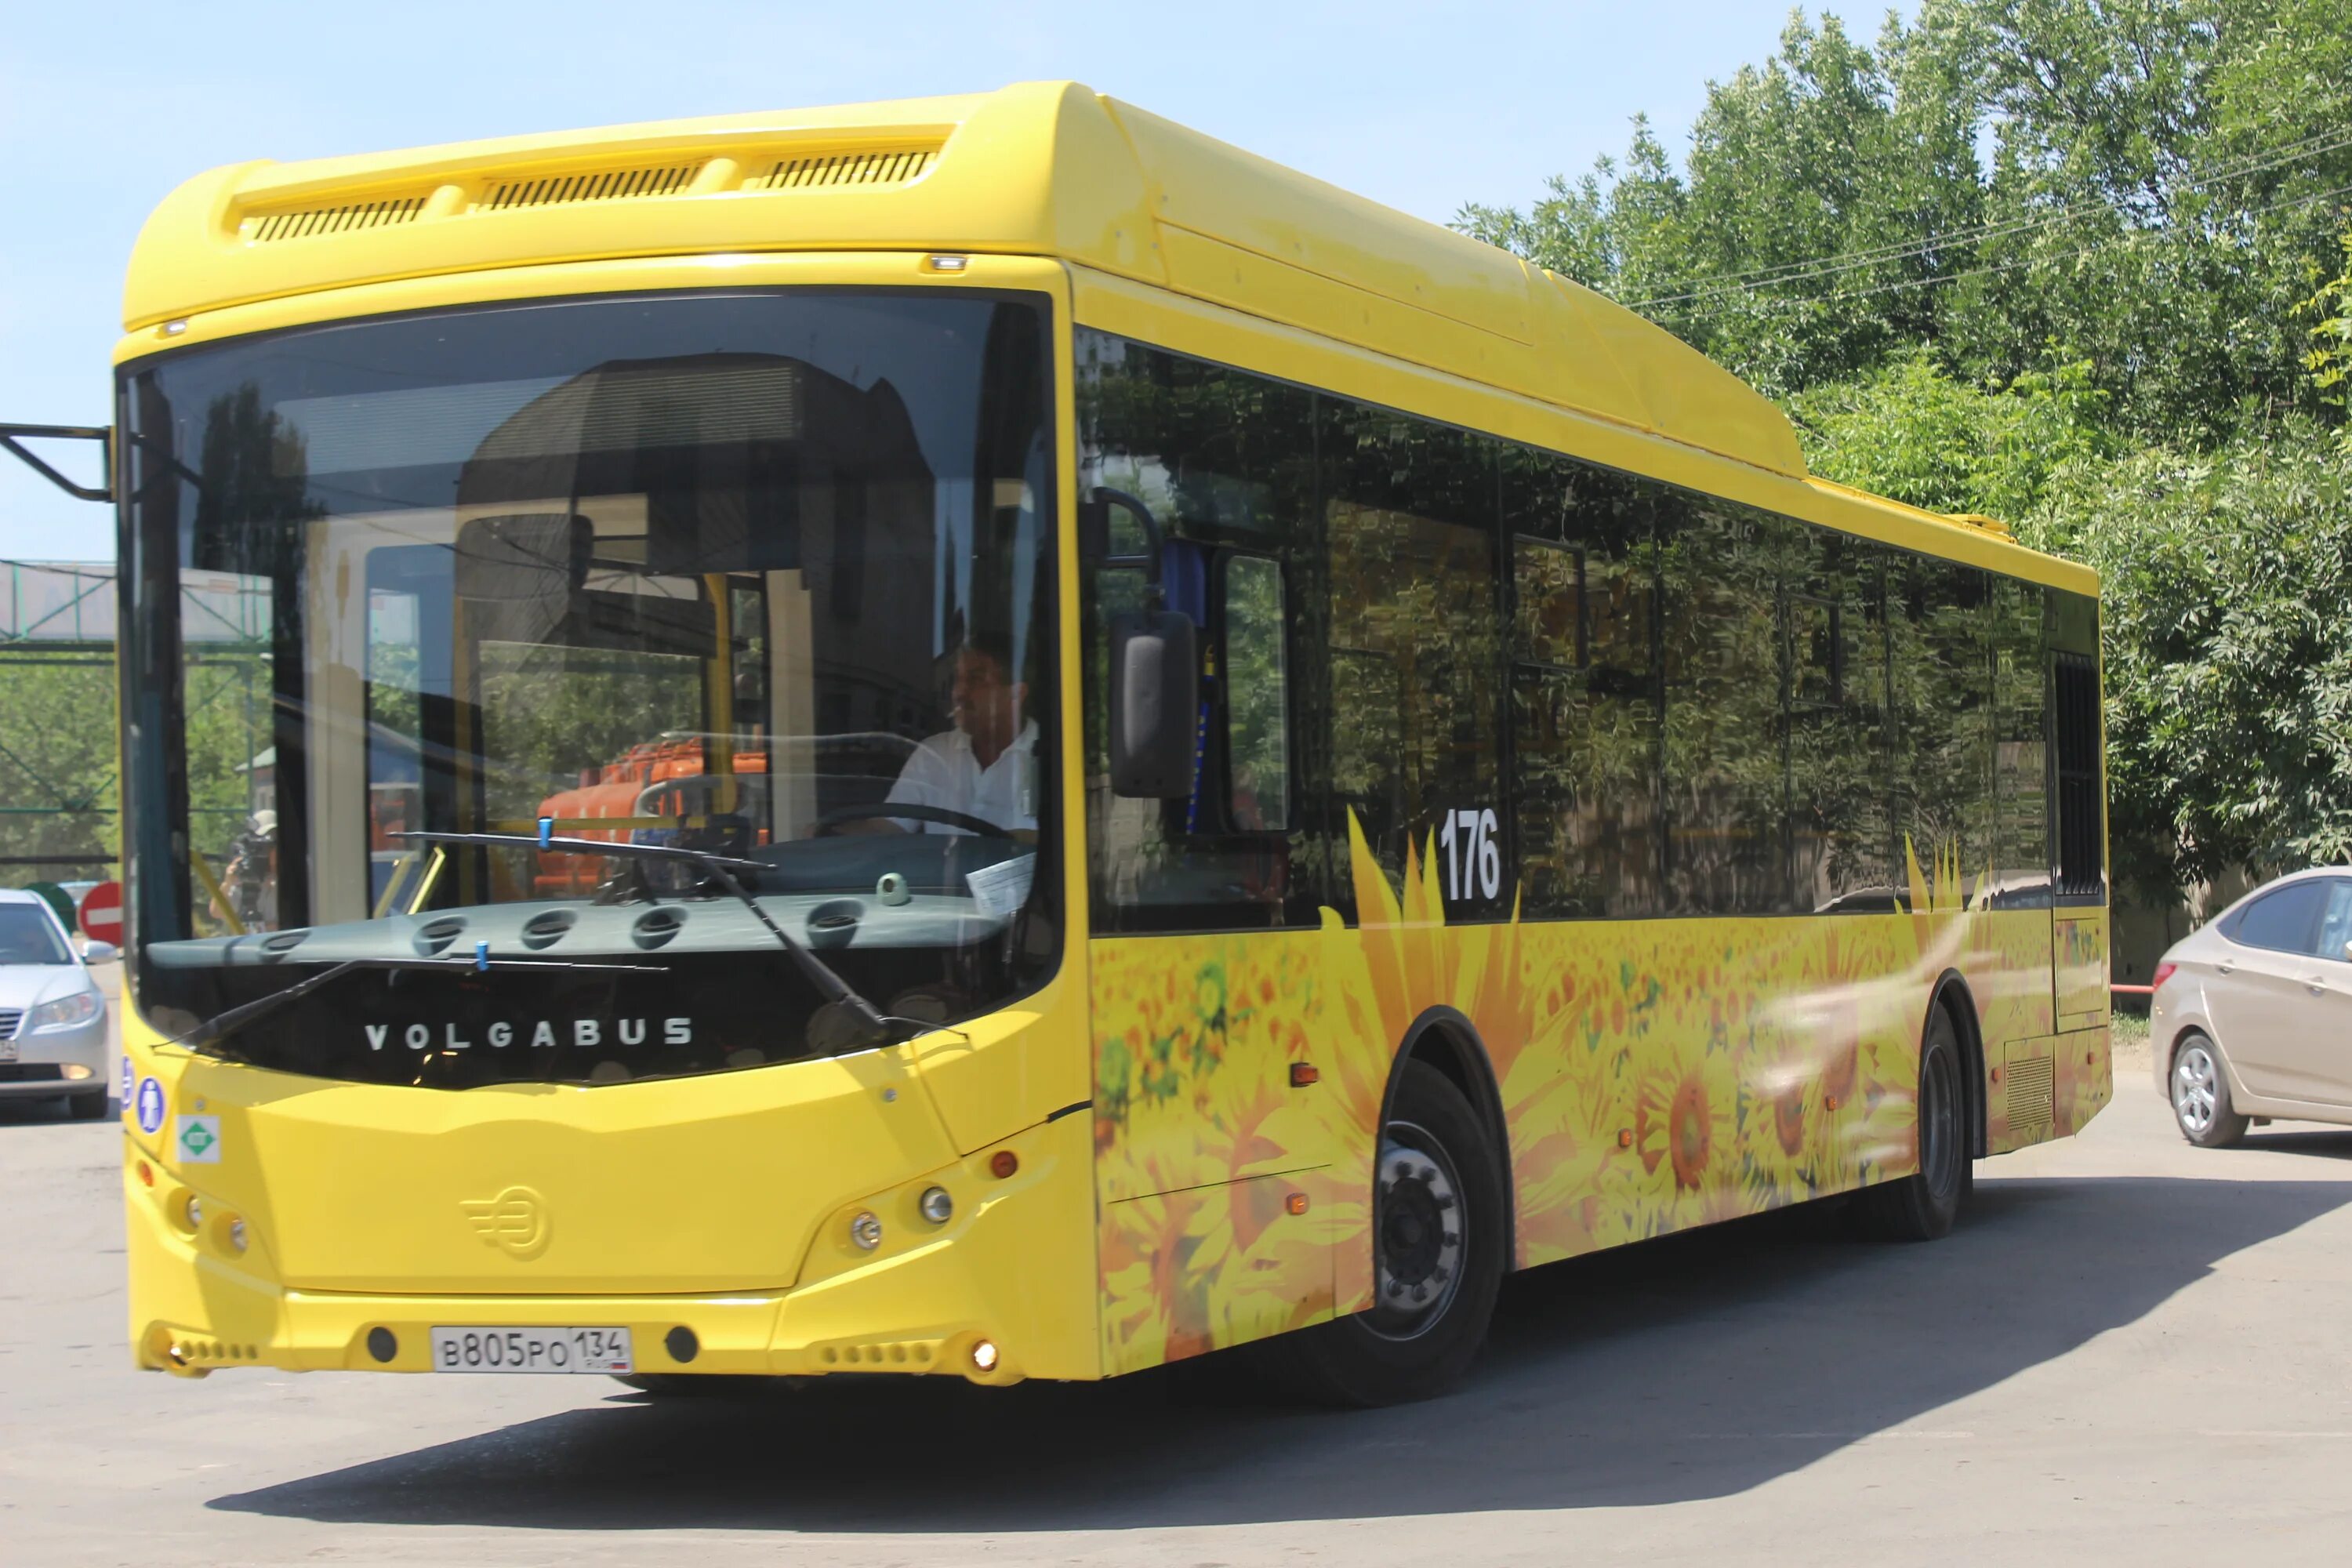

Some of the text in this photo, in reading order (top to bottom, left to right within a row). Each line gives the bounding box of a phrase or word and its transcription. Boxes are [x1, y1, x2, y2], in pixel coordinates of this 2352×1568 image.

[1441, 808, 1500, 900] 176
[365, 1018, 691, 1051] VOLGABUS
[575, 1331, 624, 1358] 134
